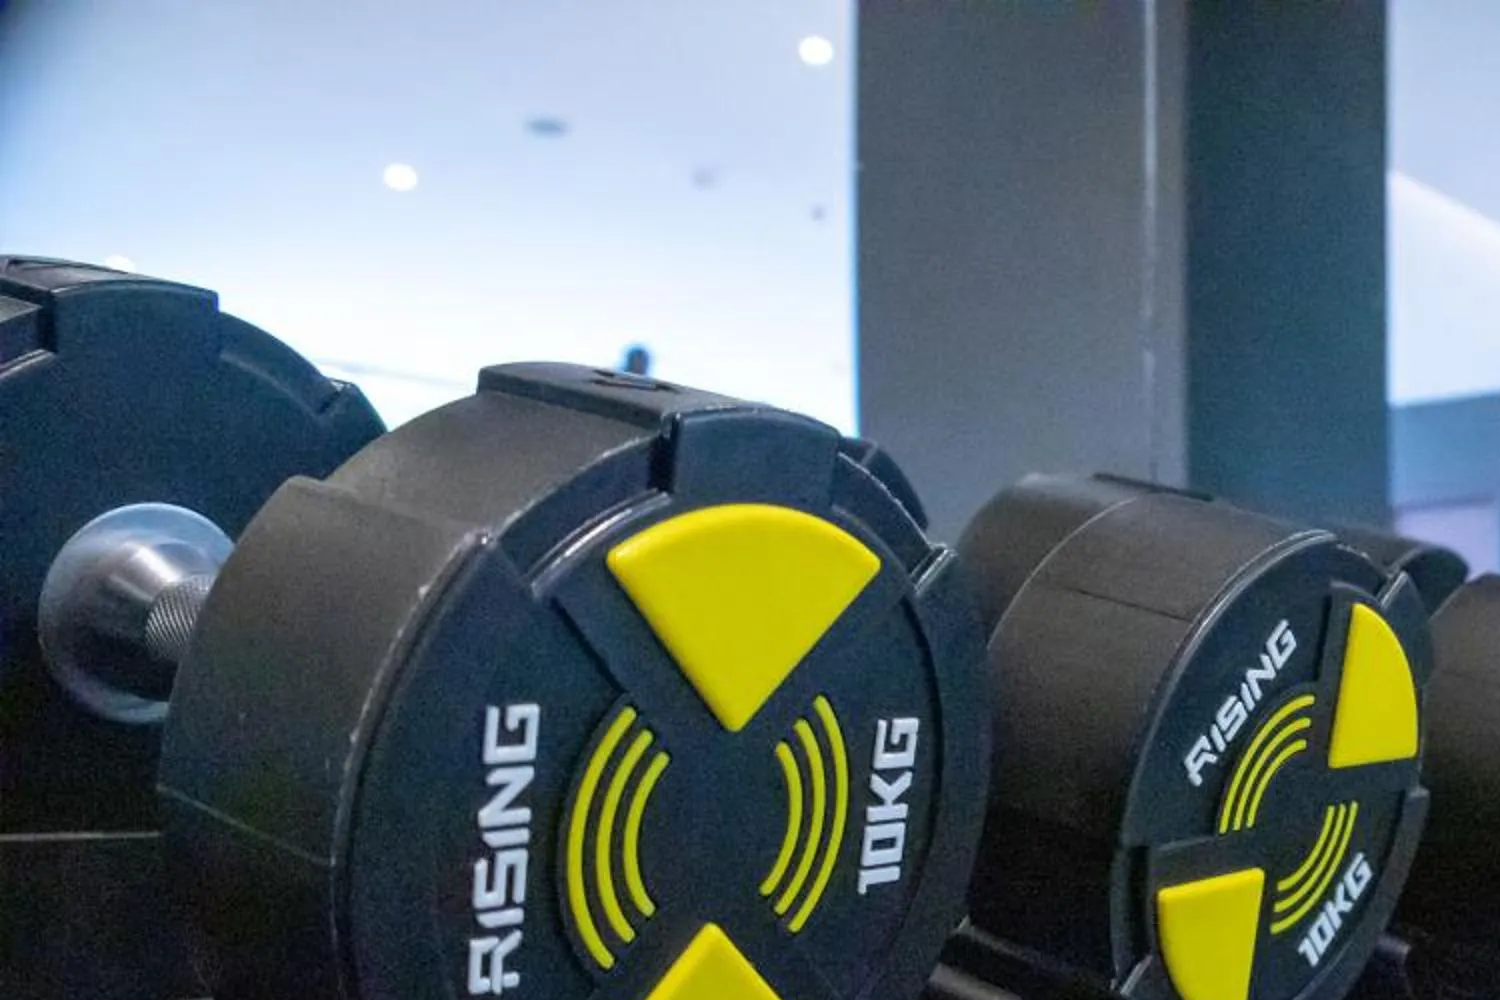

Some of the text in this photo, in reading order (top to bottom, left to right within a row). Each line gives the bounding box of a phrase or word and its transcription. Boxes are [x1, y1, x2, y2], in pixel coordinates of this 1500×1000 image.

[1183, 618, 1298, 787] RISING
[467, 702, 541, 995] RISING
[857, 716, 921, 895] 10KG
[1297, 852, 1373, 968] 10KG
